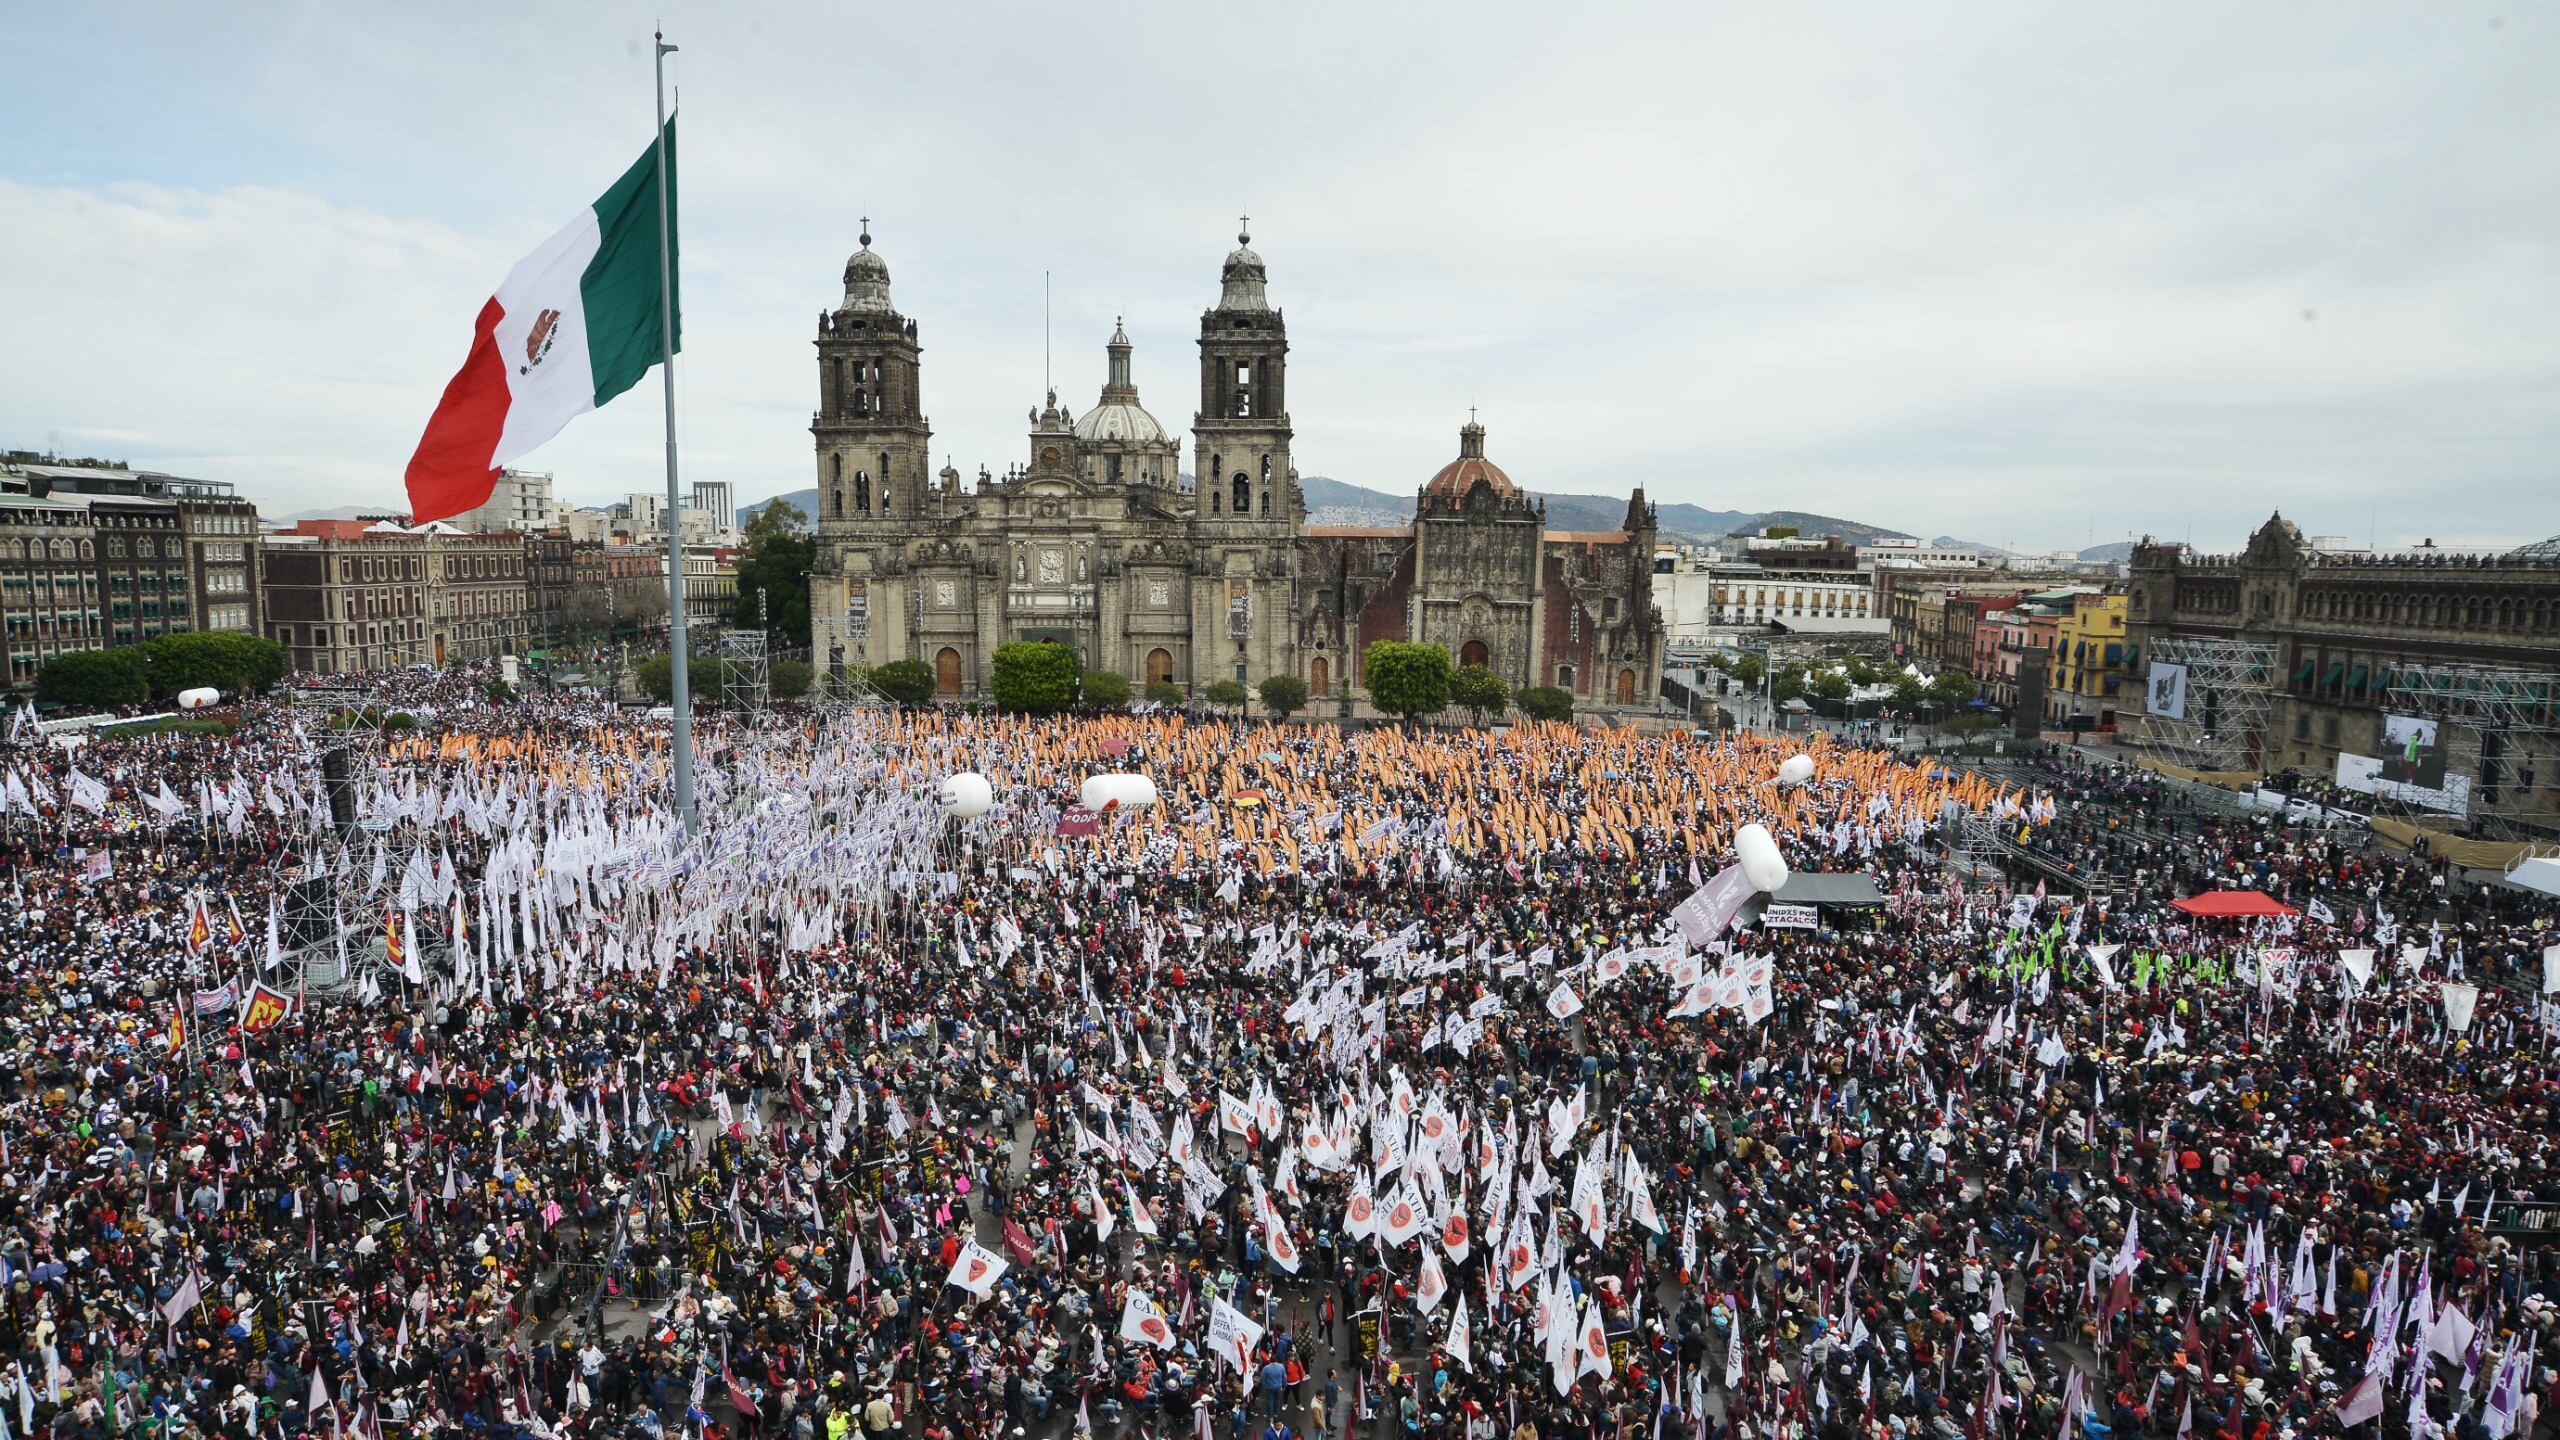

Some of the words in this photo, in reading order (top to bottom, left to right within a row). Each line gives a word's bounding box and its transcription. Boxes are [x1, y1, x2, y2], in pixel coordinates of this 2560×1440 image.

[1799, 910, 1817, 918] POR
[247, 1000, 283, 1027] PT
[1405, 1183, 1428, 1228] CATEM
